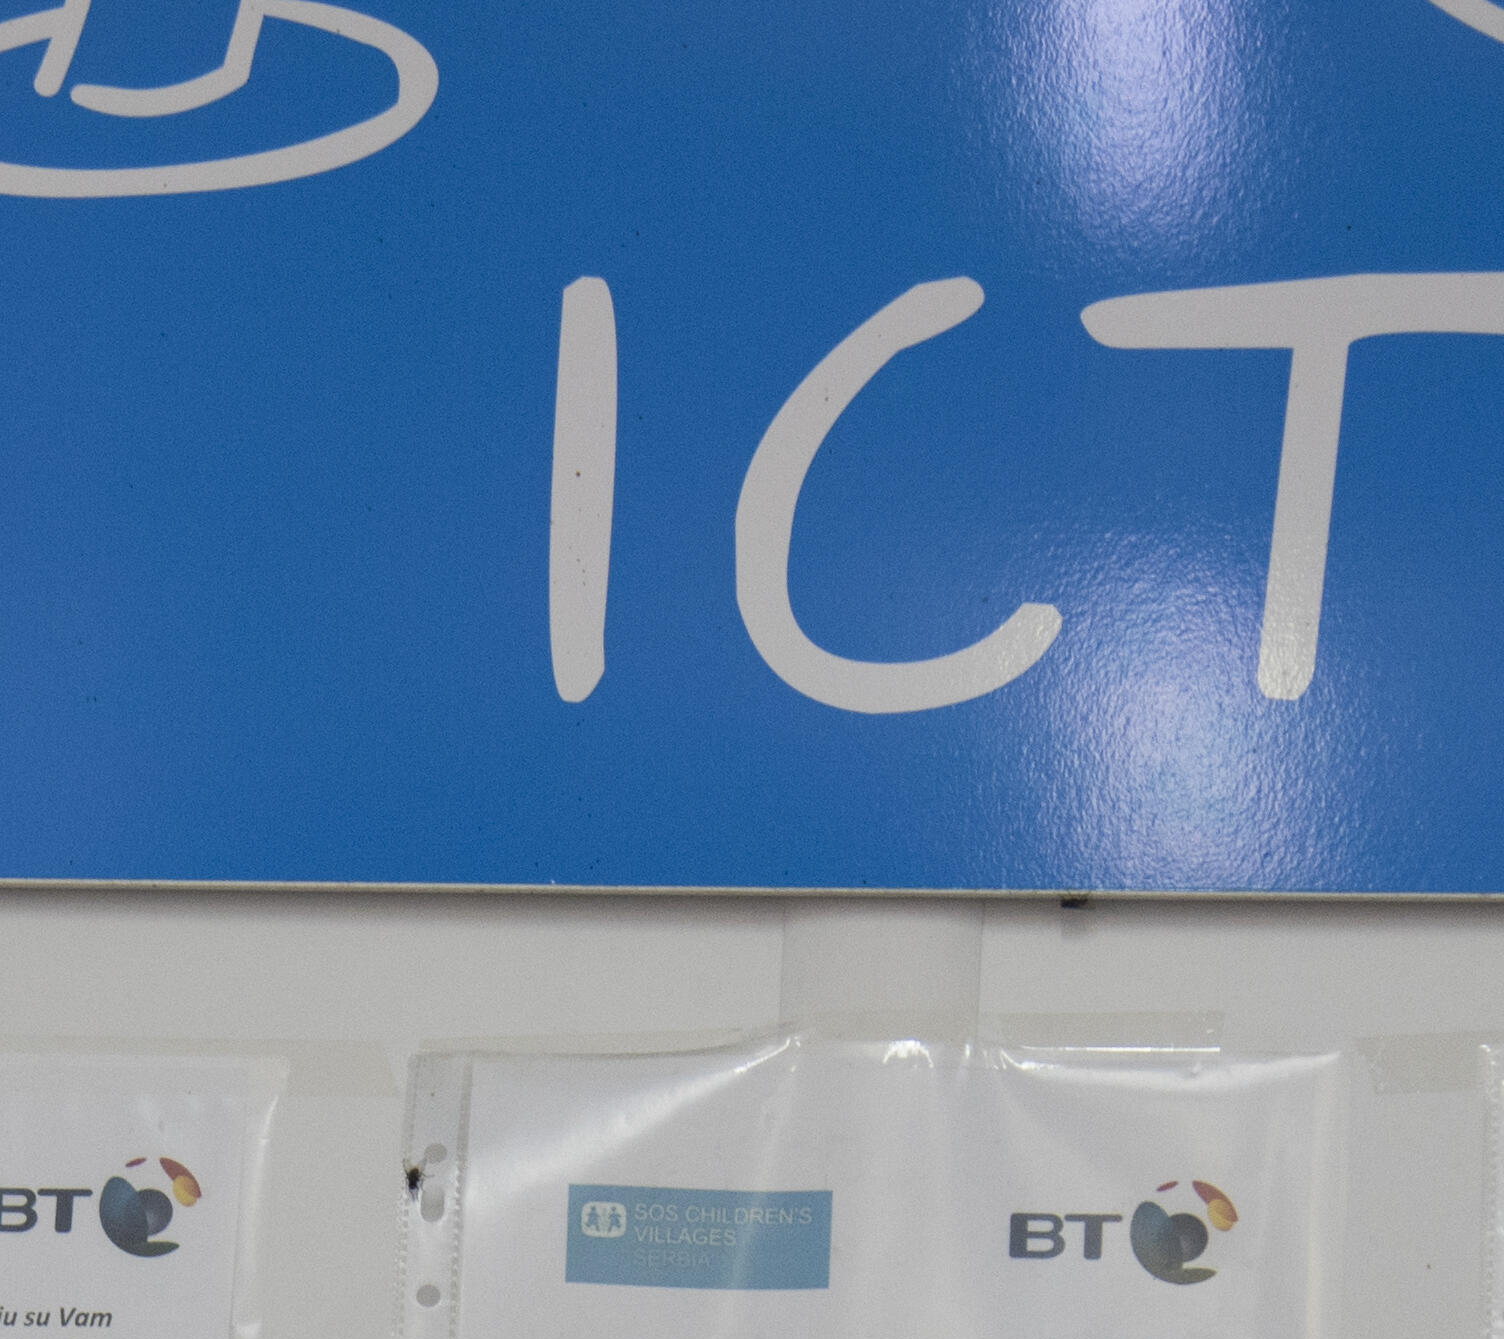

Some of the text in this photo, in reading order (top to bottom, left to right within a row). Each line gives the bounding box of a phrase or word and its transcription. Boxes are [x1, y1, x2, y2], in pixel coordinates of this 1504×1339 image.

[633, 1203, 679, 1222] SOS
[633, 1226, 737, 1247] VILLAGES
[1007, 1211, 1123, 1261] BT
[24, 1310, 52, 1329] su
[57, 1305, 115, 1330] Vam
